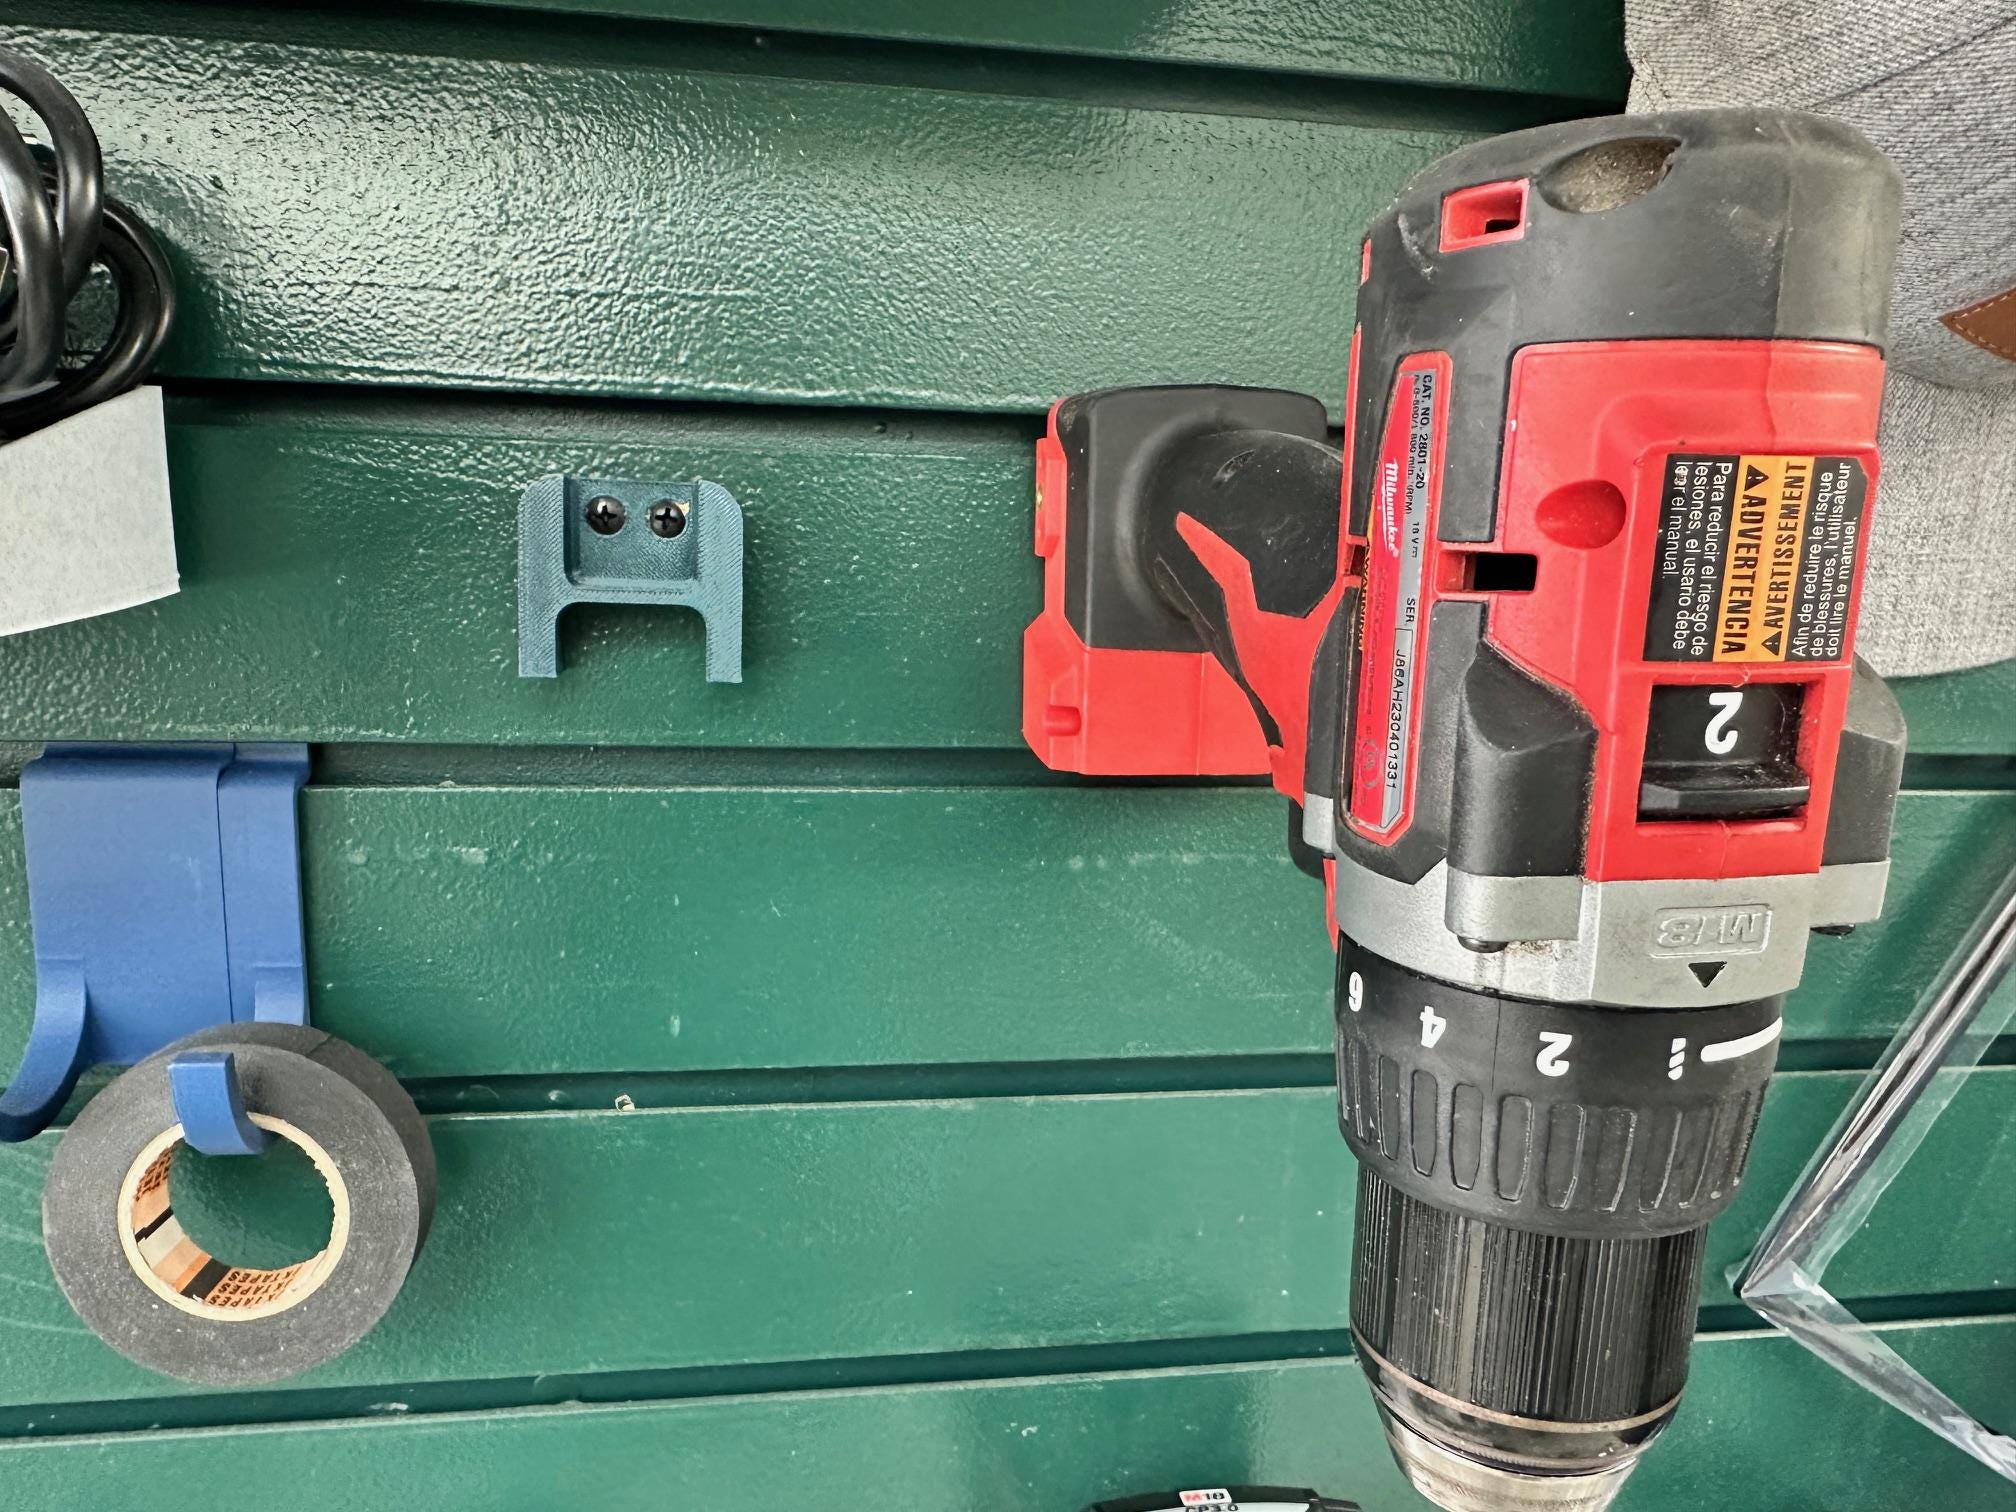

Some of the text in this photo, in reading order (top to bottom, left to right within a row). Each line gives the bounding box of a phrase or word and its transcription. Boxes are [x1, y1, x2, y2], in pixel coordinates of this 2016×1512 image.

[1416, 374, 1433, 489] CAT. NO. 2801-20
[1382, 458, 1399, 552] Milwaukee
[1670, 496, 1688, 511] el
[1812, 472, 1834, 521] risque
[1412, 521, 1420, 534] 18
[1662, 515, 1682, 579] manual.
[1763, 461, 1807, 629] AVERTISSEMENT
[1808, 525, 1824, 540] le
[1673, 462, 1713, 649] lesiones, el usario debe
[1690, 462, 1733, 655] Para reducir el riesgo de
[1721, 494, 1767, 654] ADVERTENCIA
[1809, 462, 1851, 657] de blessures, l'utilisateur
[1825, 517, 1858, 657] doit lire le manuel.
[1797, 603, 1814, 623] de
[1791, 626, 1810, 657] Afin
[1386, 648, 1407, 788] J86AH230401331
[1705, 691, 1743, 754] 2
[1657, 911, 1763, 949] M18
[1348, 971, 1364, 1012] 6
[1419, 1005, 1447, 1049] 4
[1535, 1031, 1573, 1077] 2
[218, 1282, 272, 1295] TAPES
[228, 1270, 281, 1284] TAPES
